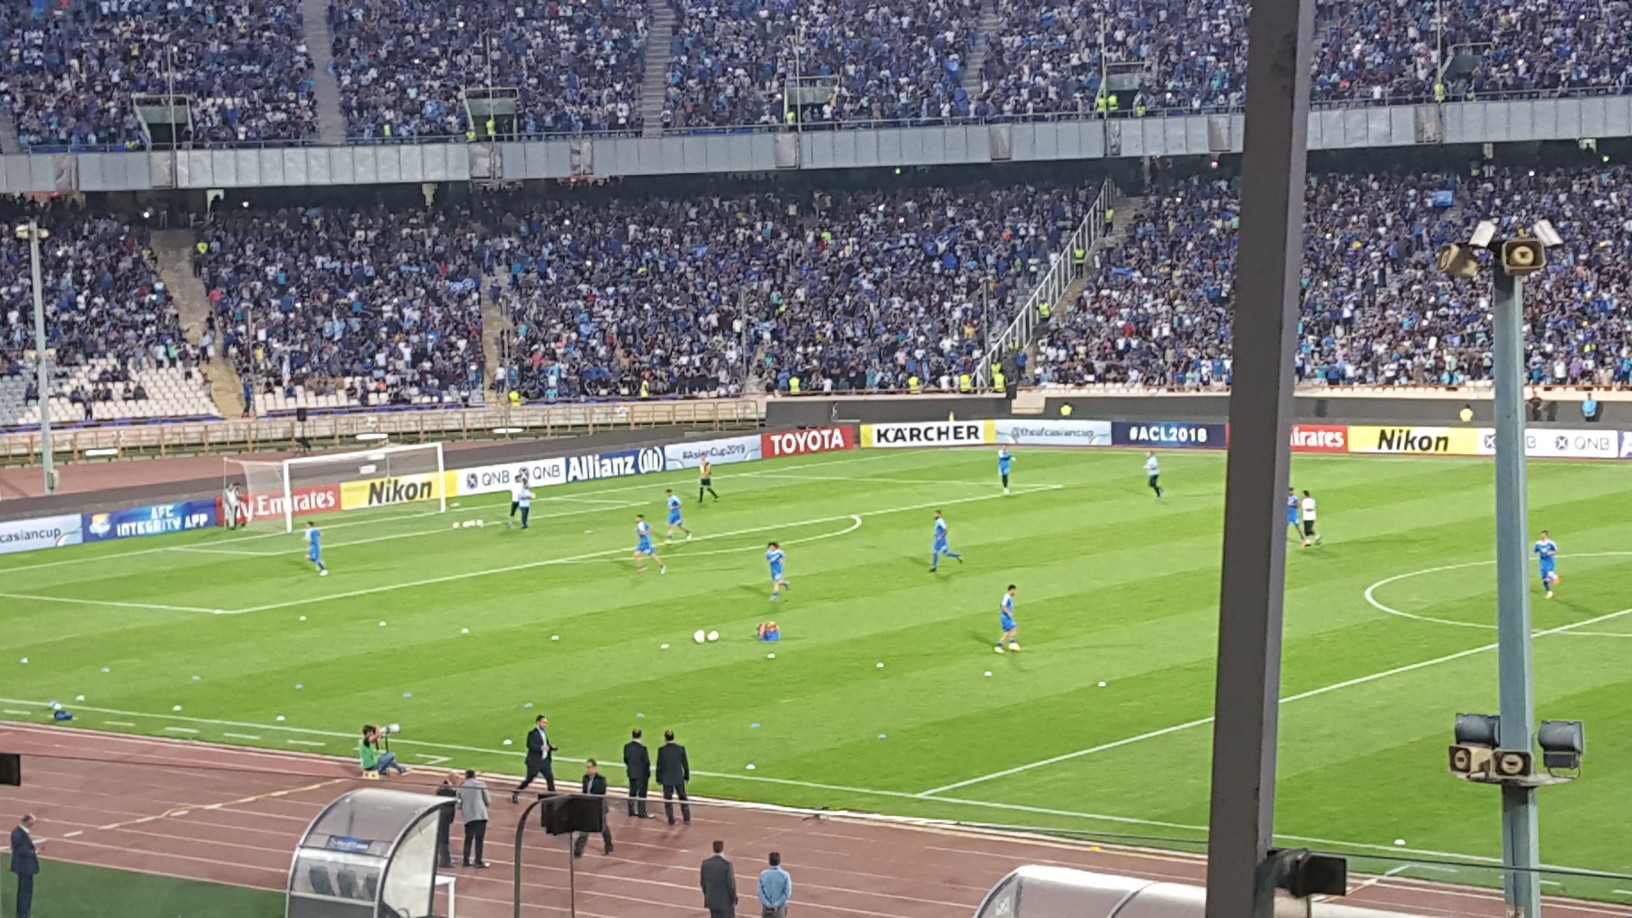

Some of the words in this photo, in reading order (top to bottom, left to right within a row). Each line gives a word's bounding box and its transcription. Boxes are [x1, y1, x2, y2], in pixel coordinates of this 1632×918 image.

[770, 428, 845, 455] TOYOTA
[876, 425, 980, 443] KÄRCHER
[1129, 427, 1208, 443] #ACL2018
[1377, 428, 1449, 452] Nikon
[1573, 434, 1610, 451] QNB
[481, 469, 510, 487] QNB
[532, 464, 561, 480] QNB
[567, 454, 636, 482] Allianz
[368, 481, 433, 505] Nikon
[151, 504, 174, 520] AFC
[116, 516, 182, 537] INTEGRITY
[184, 513, 208, 529] APP
